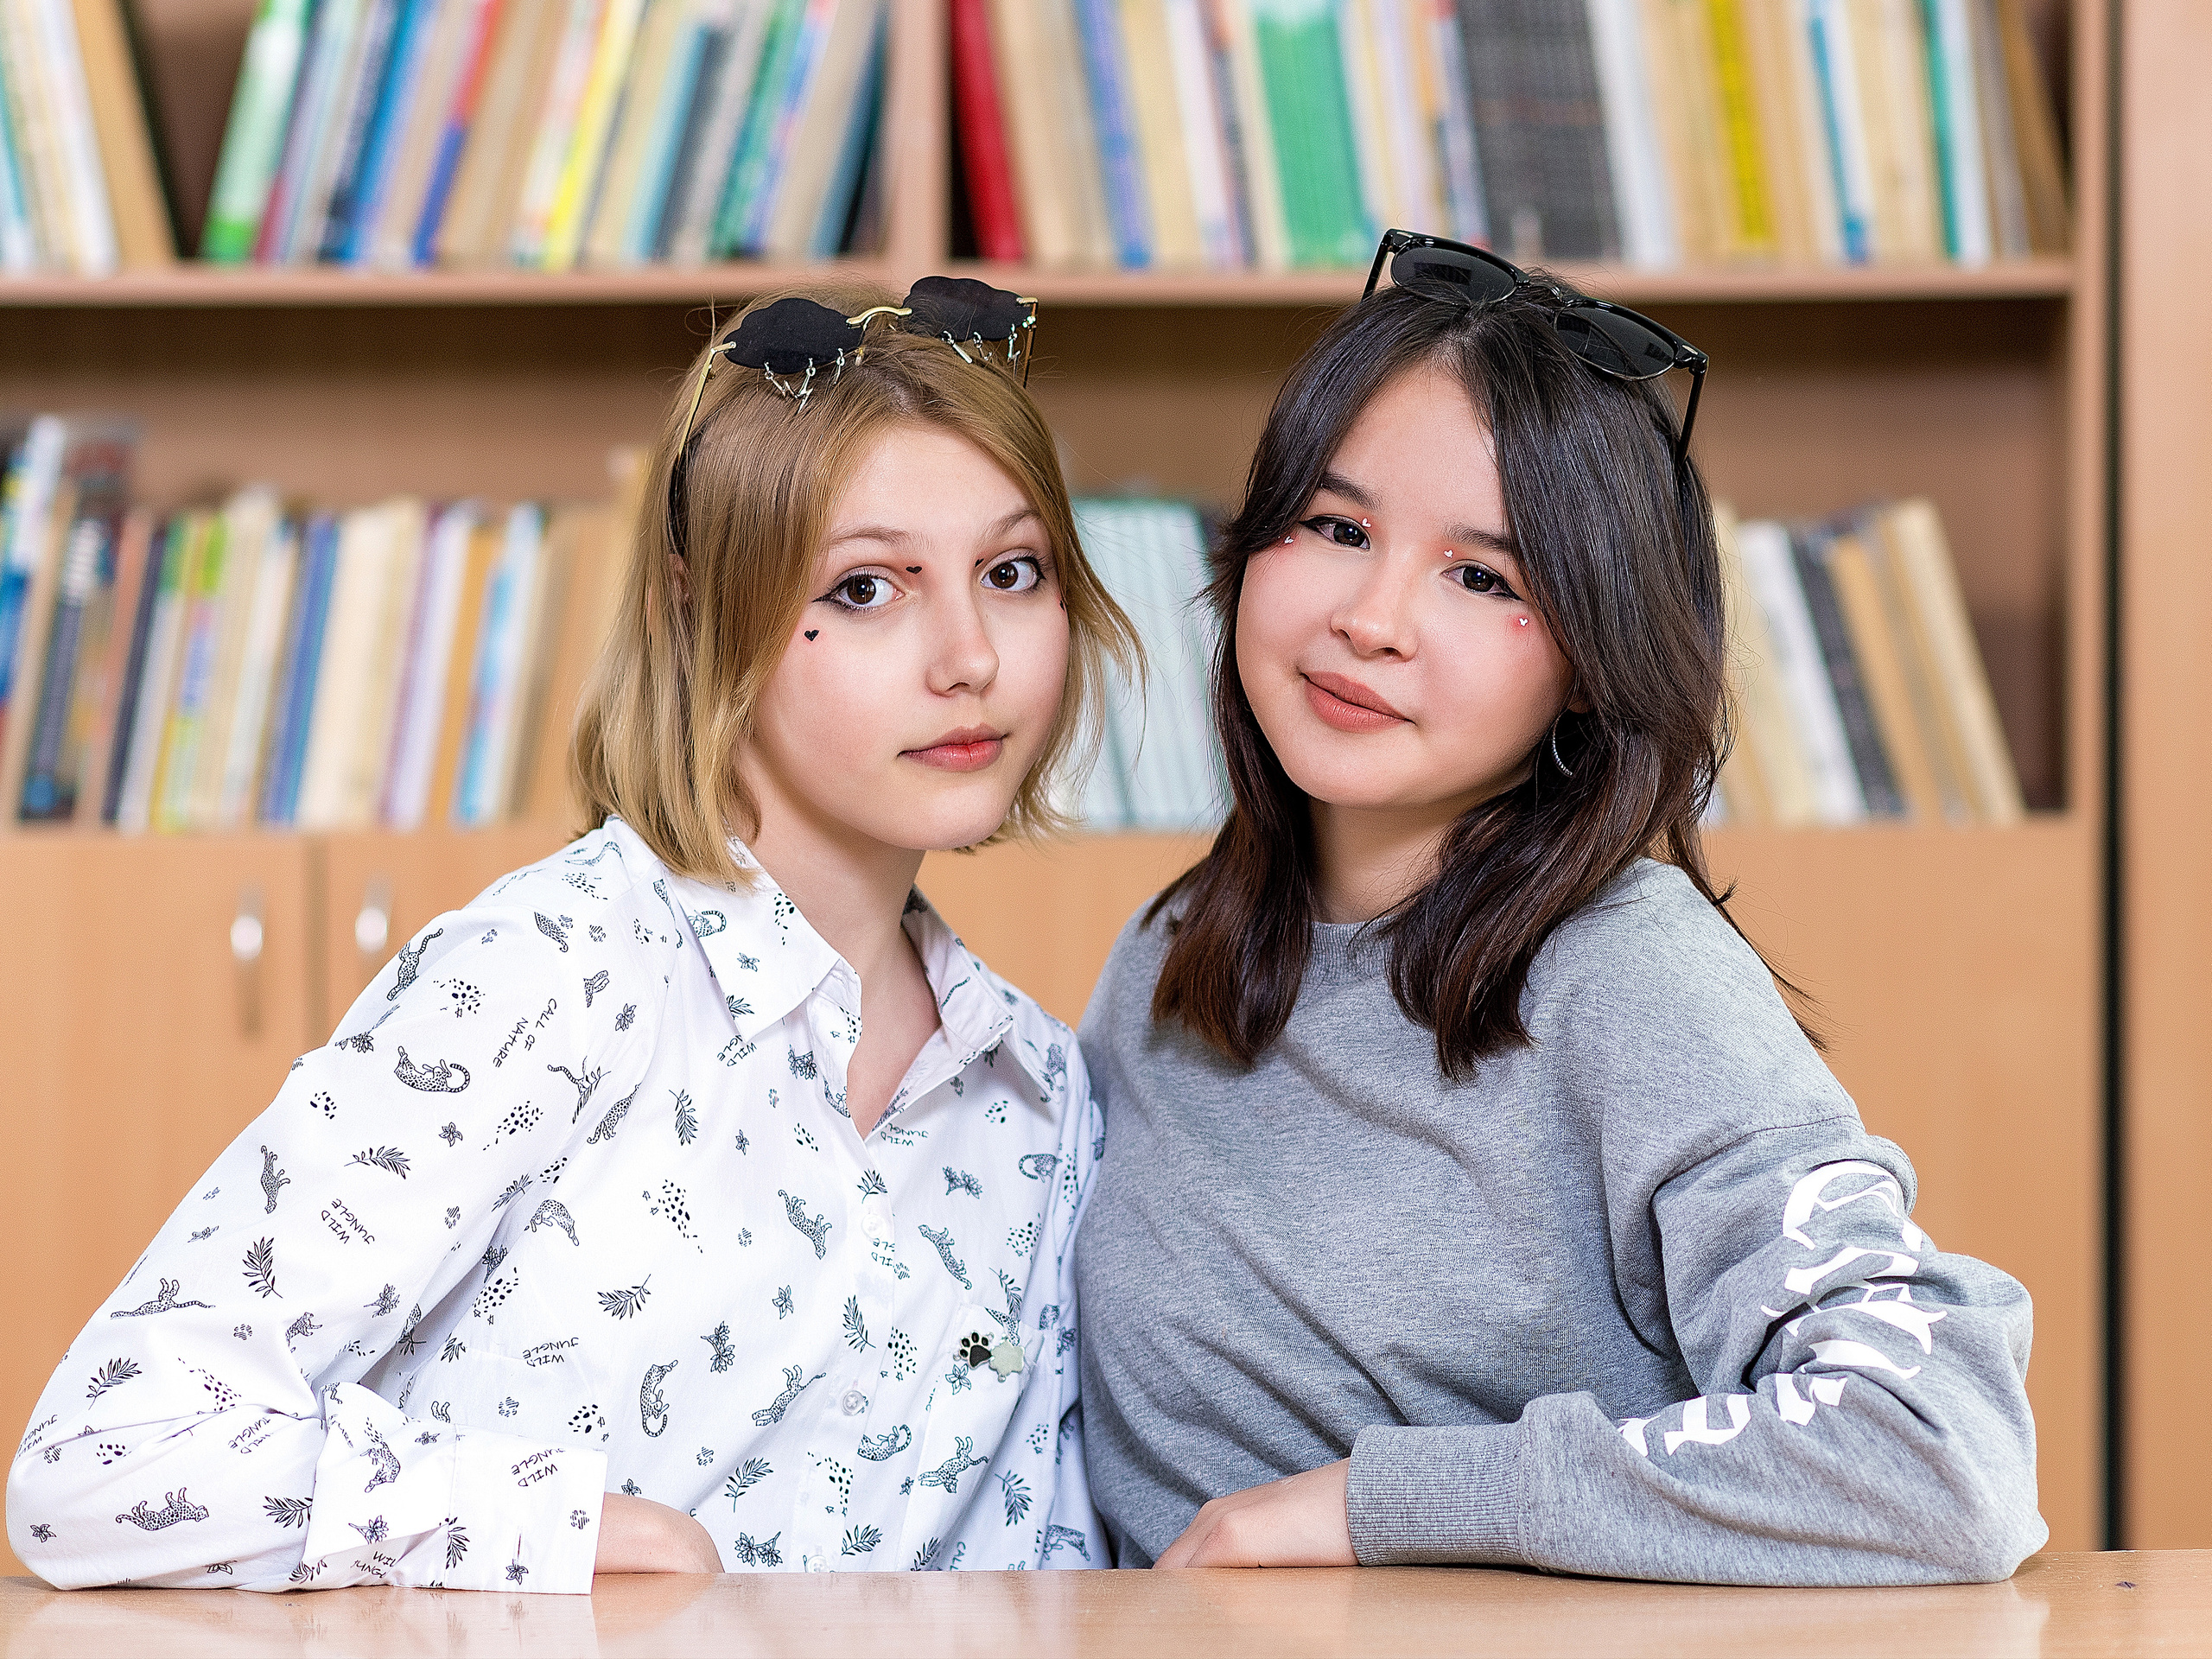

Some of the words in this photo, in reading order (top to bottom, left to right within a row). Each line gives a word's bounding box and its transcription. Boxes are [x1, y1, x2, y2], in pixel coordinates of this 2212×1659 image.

[536, 998, 557, 1028] CALL
[493, 1017, 529, 1068] NATURE
[524, 1034, 535, 1051] OF
[727, 1042, 757, 1067] WILD
[880, 1131, 914, 1147] WILD
[886, 1122, 929, 1138] JUNGL
[321, 1210, 350, 1244] WILD
[331, 1198, 375, 1245] JUNGLE
[871, 1251, 894, 1267] ILD
[522, 1337, 579, 1359] JUNGLE
[518, 1464, 558, 1487] WILD
[372, 1551, 397, 1567] WIL
[950, 1541, 966, 1571] CALL
